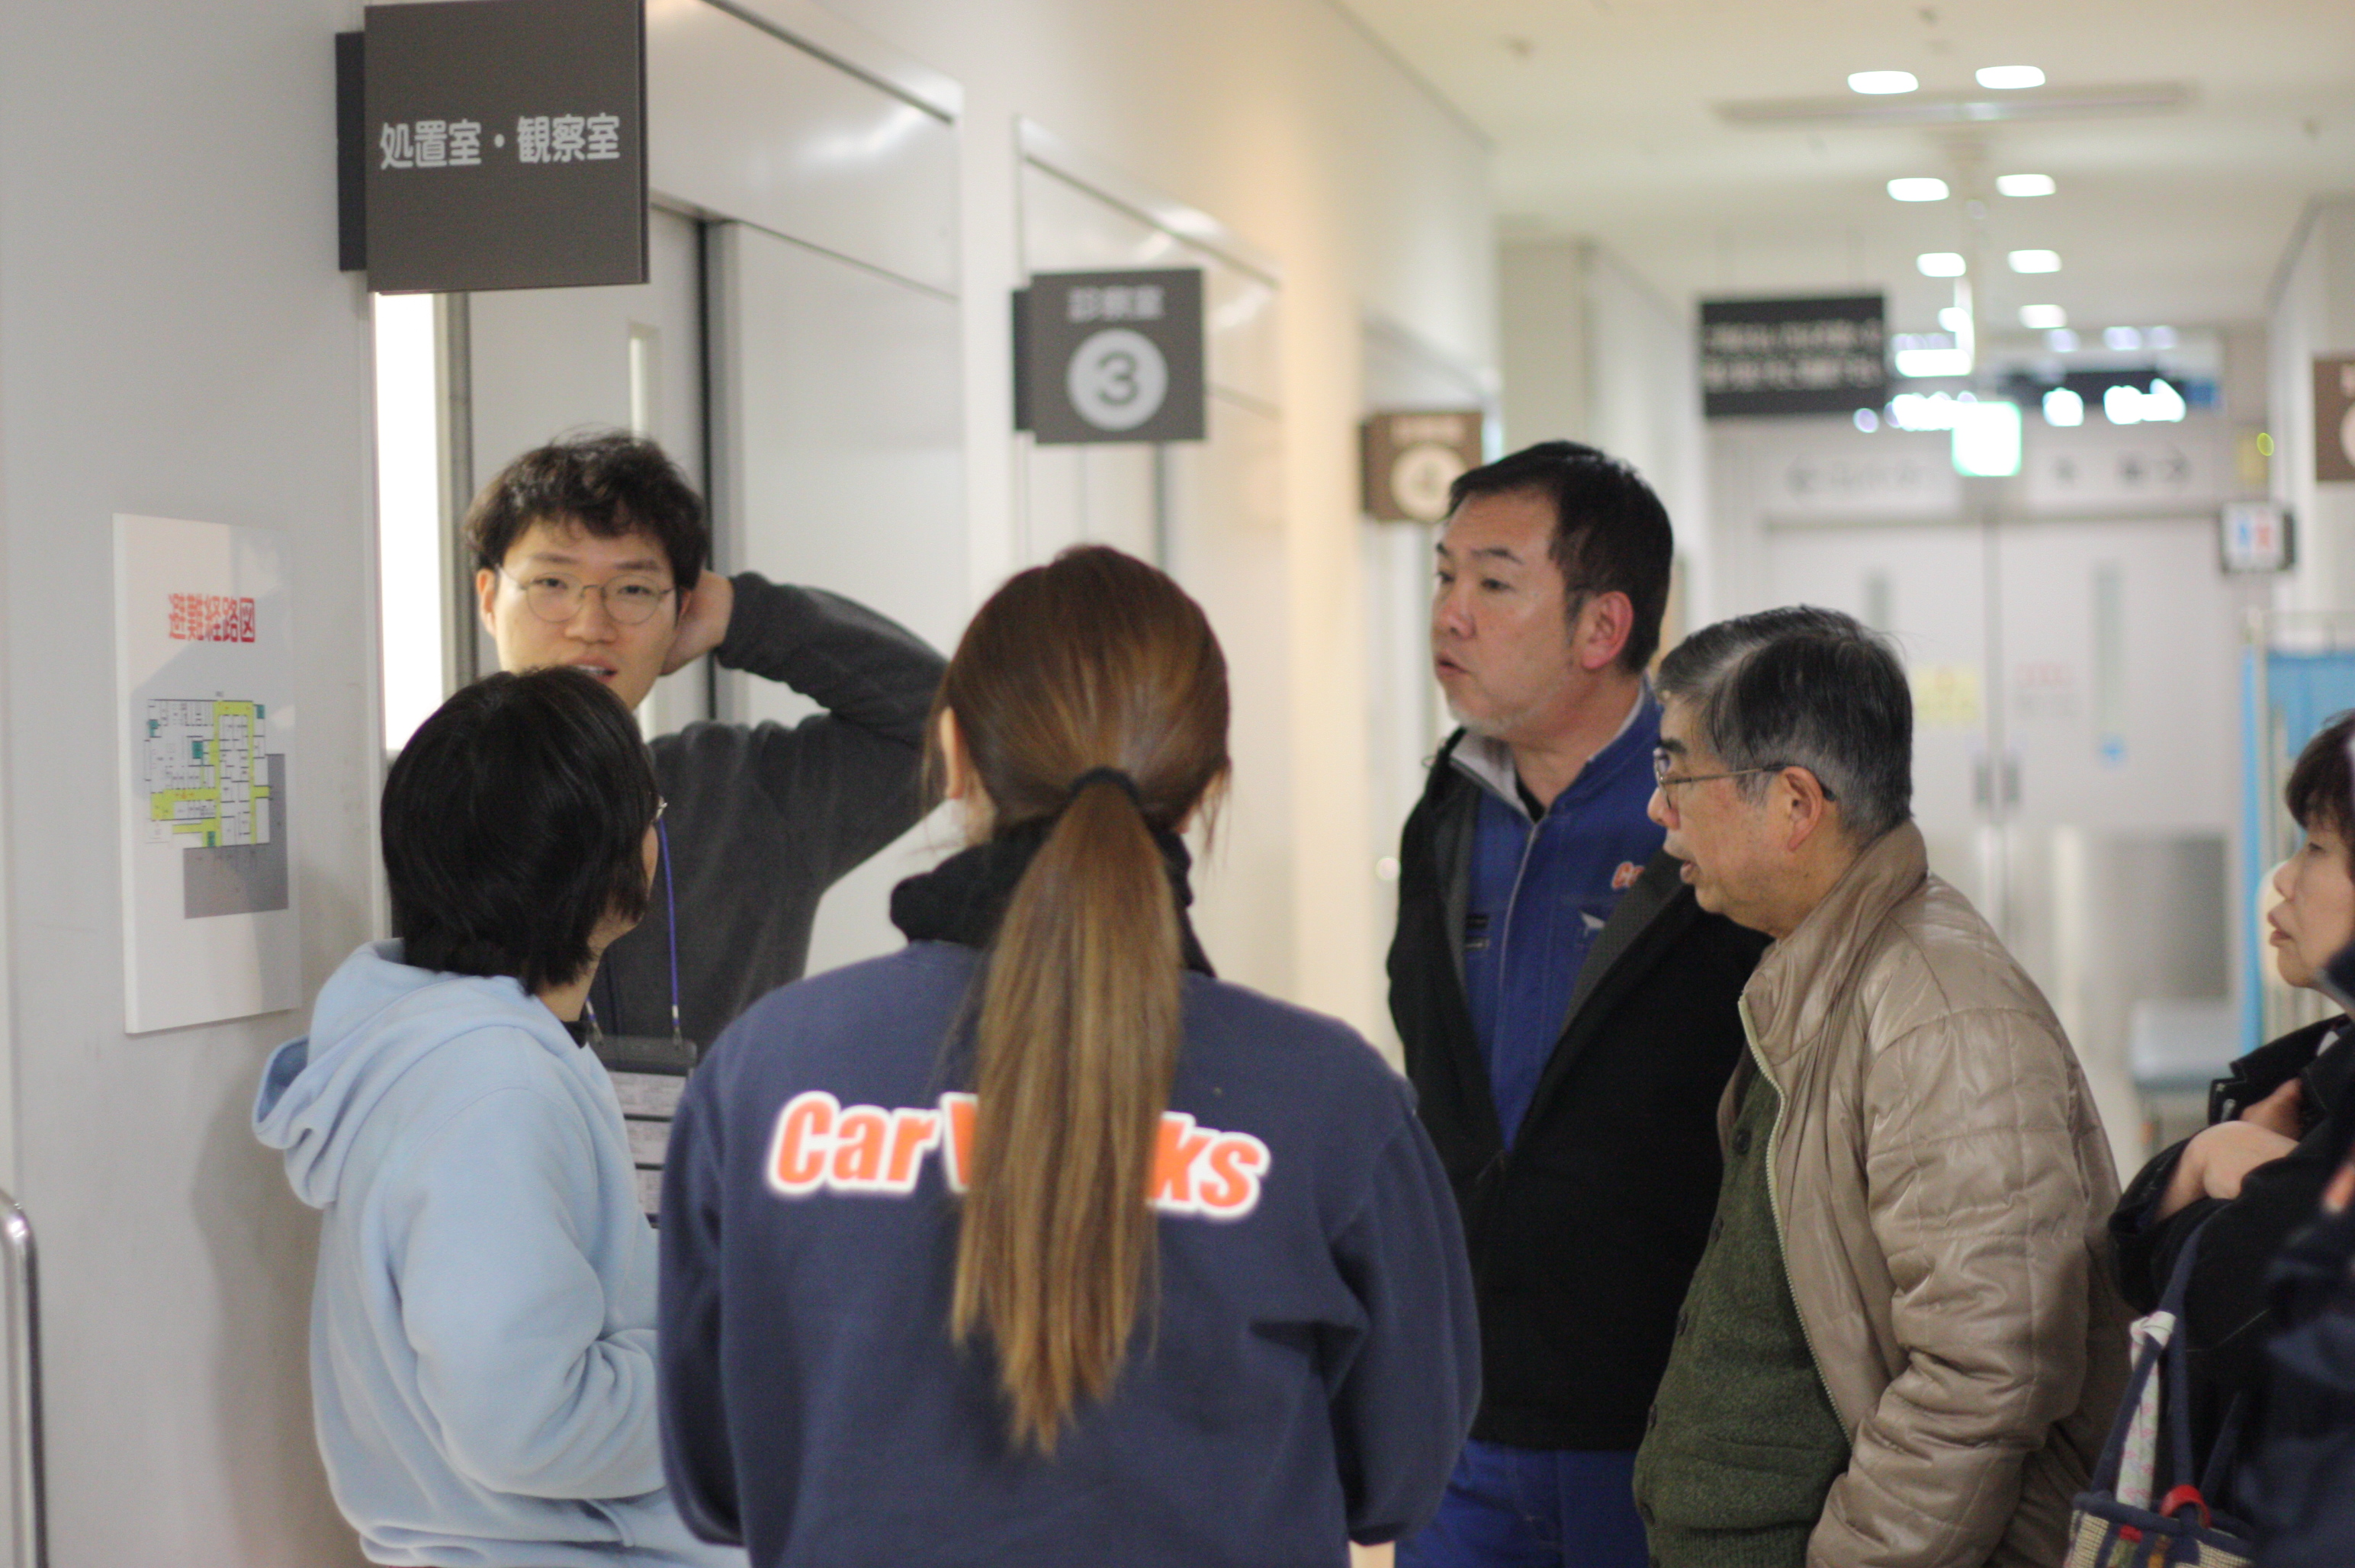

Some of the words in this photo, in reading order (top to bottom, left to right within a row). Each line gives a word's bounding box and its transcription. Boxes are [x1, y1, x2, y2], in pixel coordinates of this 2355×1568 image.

[380, 112, 620, 170] 処置室・観察室
[1097, 350, 1140, 406] 3
[771, 1092, 940, 1192] Car
